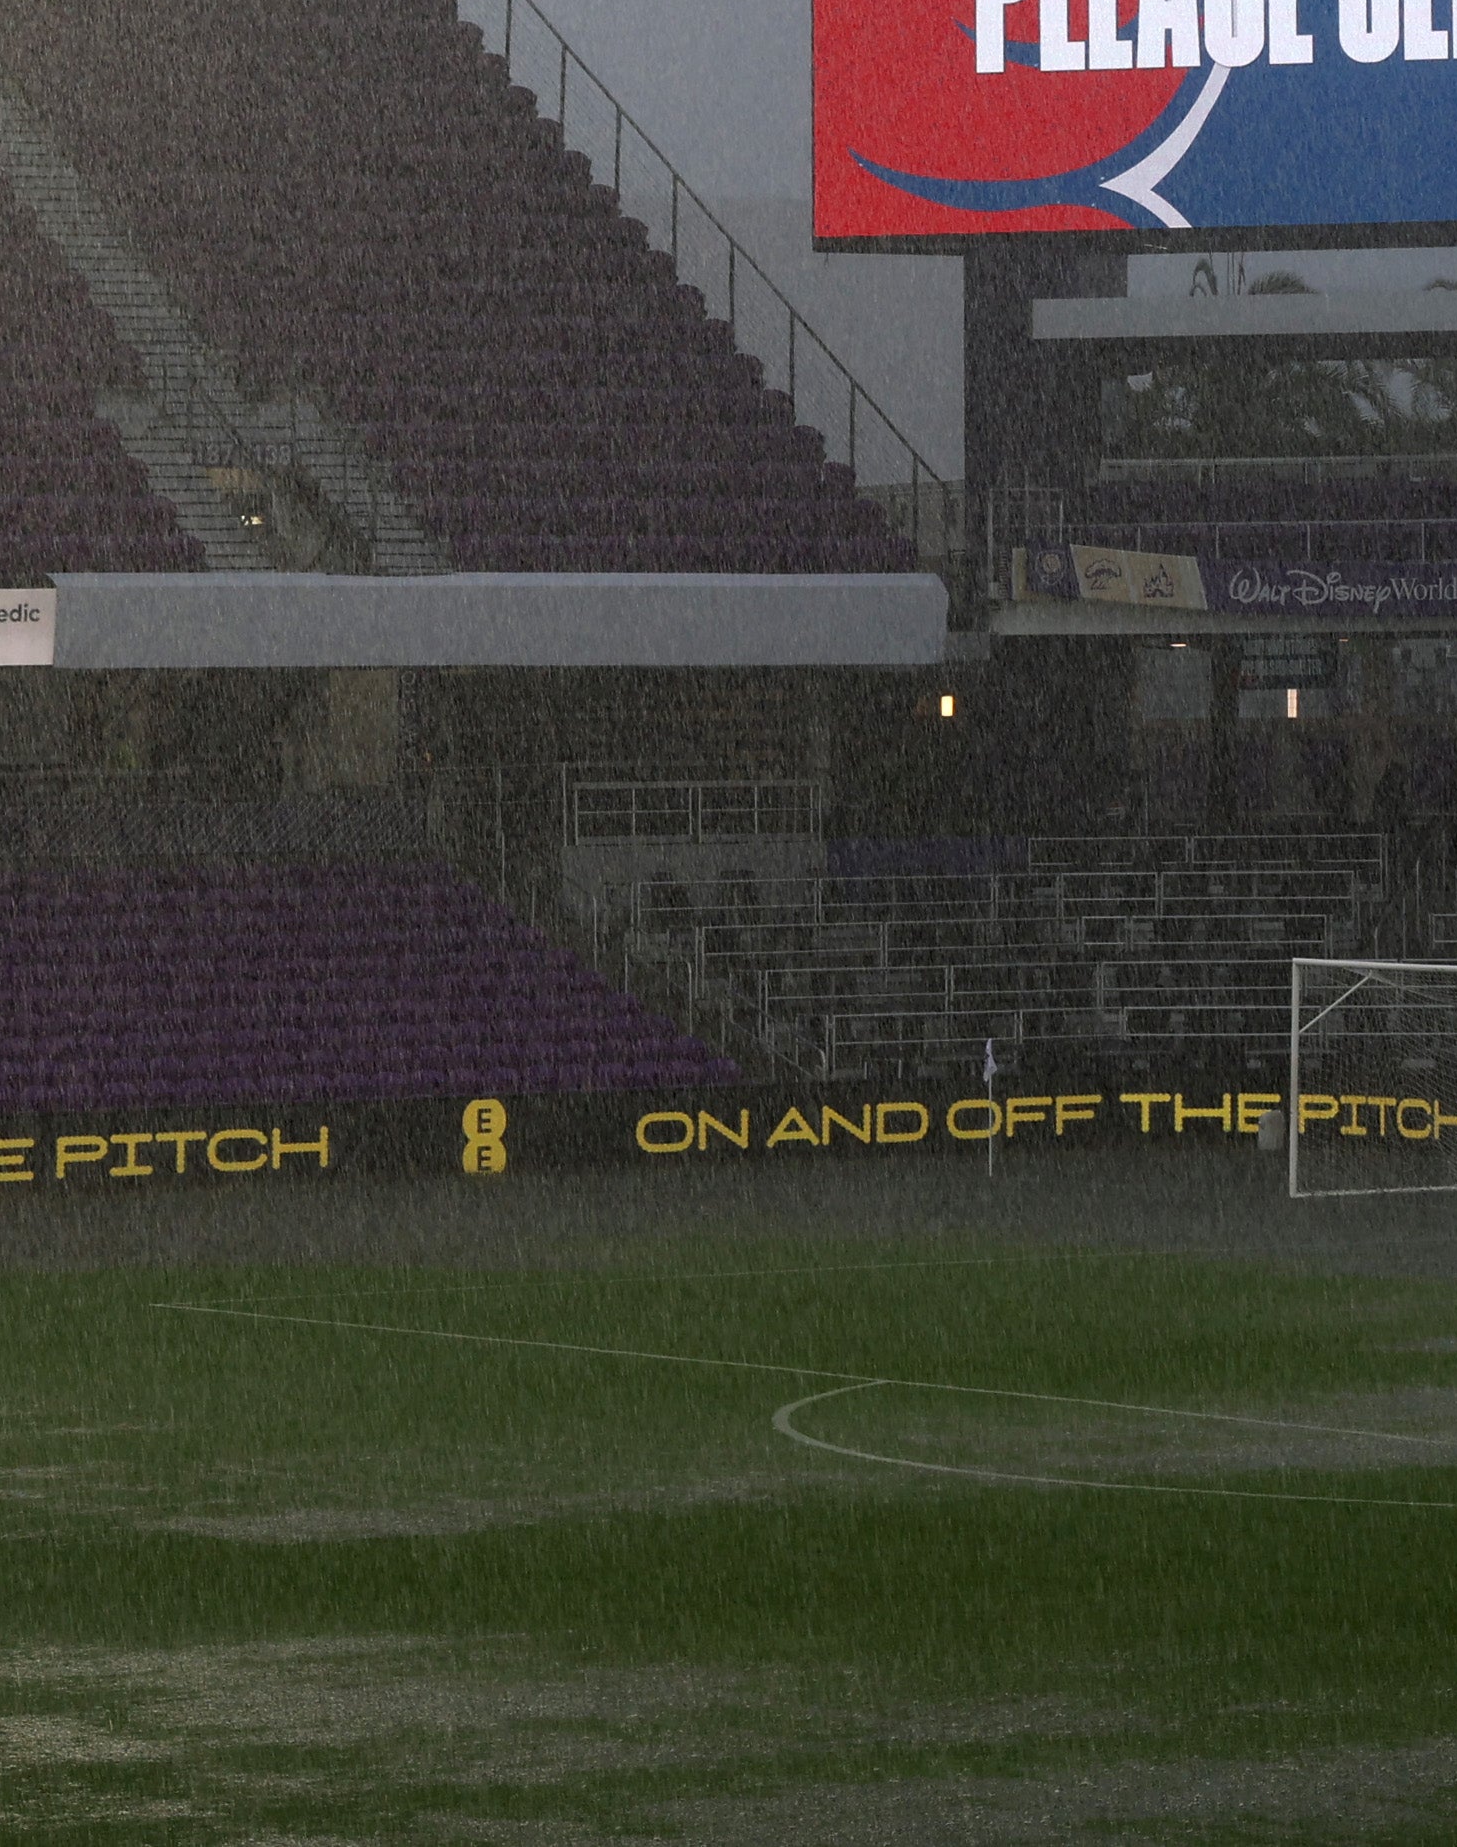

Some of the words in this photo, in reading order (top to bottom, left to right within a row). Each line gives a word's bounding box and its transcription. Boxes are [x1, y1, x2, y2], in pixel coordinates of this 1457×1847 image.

[635, 1108, 750, 1153] ON
[767, 1101, 930, 1148] AND
[947, 1094, 1103, 1140] OFF
[1119, 1092, 1282, 1133] THE
[56, 1125, 330, 1180] PITCH
